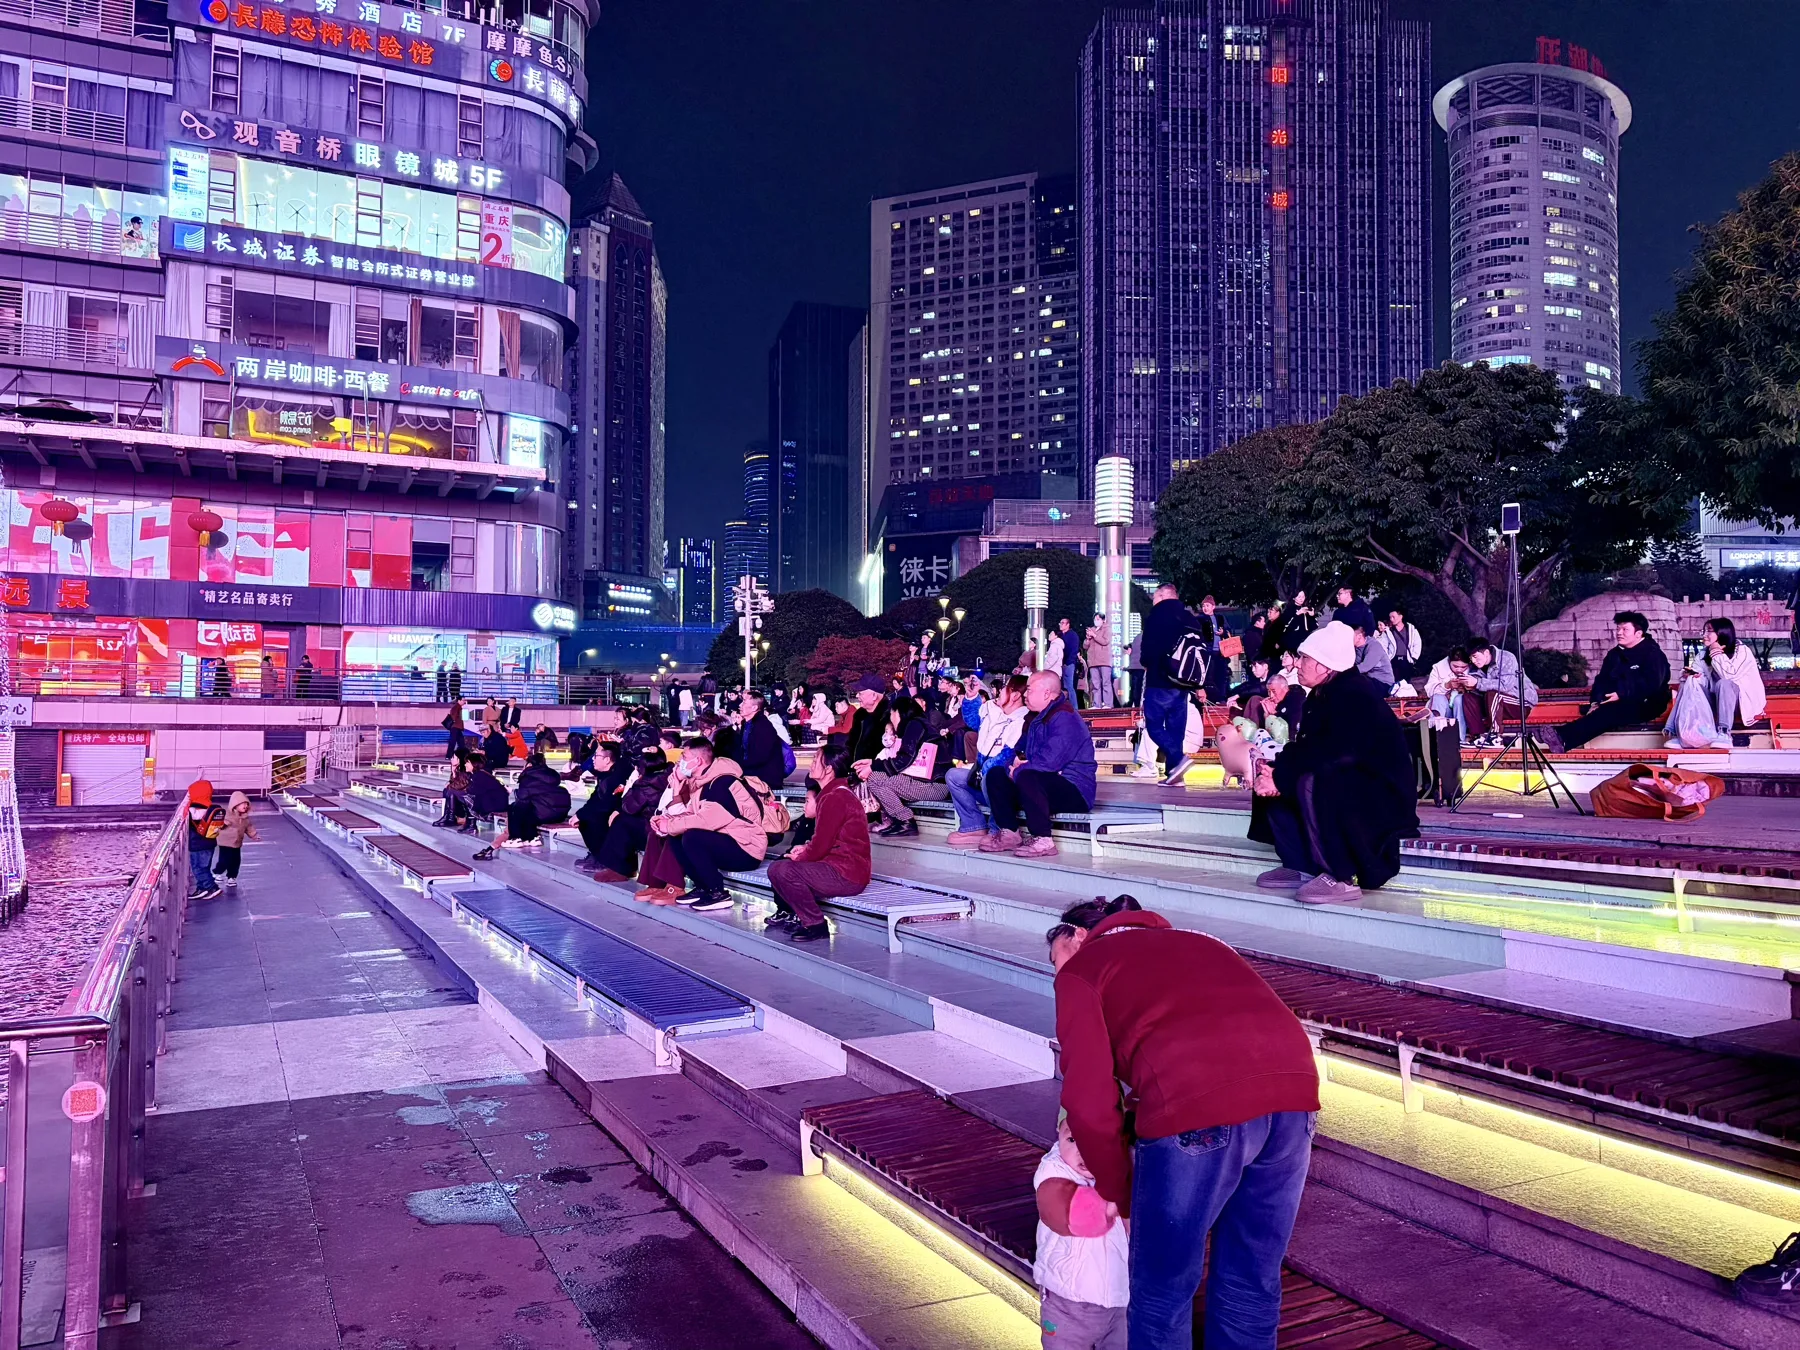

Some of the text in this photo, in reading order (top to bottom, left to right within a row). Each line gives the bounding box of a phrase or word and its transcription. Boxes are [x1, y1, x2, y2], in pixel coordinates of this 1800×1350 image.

[231, 5, 434, 65] 長藤恐怖体验馆
[274, 0, 466, 43] 秀酒店 7F
[1272, 66, 1288, 207] 阳光城
[470, 165, 503, 189] 5F
[484, 213, 509, 226] 重庆
[212, 231, 476, 288] 长城证券 智能会所式证券营业部
[900, 556, 948, 584] 徕卡
[204, 590, 293, 606] 精艺名品寄卖行
[388, 633, 434, 644] HUAWEI
